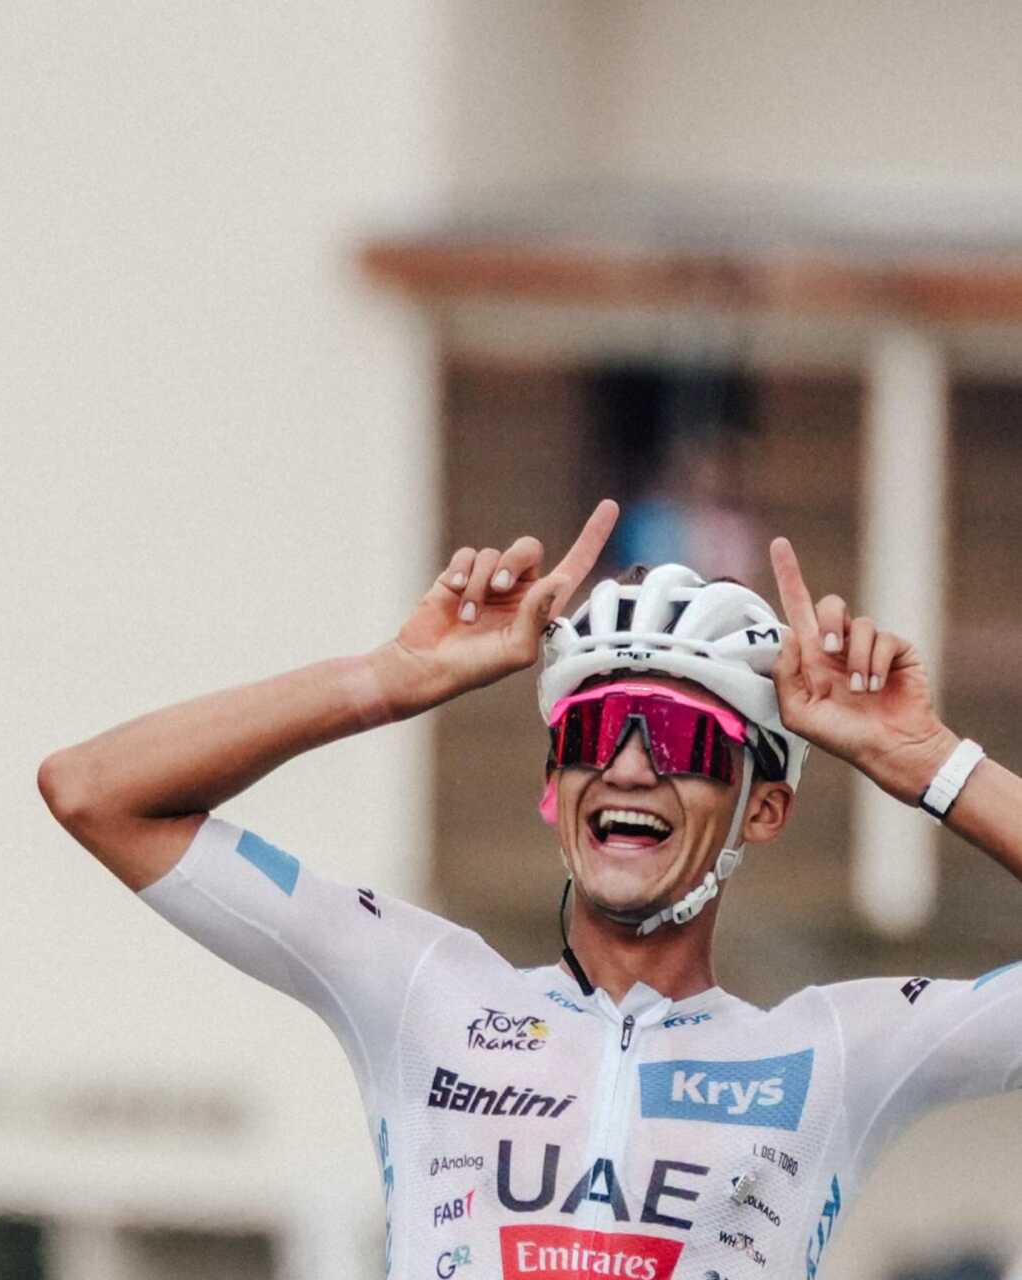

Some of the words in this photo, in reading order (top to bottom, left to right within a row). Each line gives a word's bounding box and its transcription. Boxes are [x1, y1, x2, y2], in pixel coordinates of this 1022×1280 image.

[428, 1066, 578, 1119] Santini
[671, 1069, 785, 1115] Krys
[441, 1154, 484, 1171] Analog
[497, 1139, 711, 1231] UAE
[516, 1241, 659, 1280] Emirates
